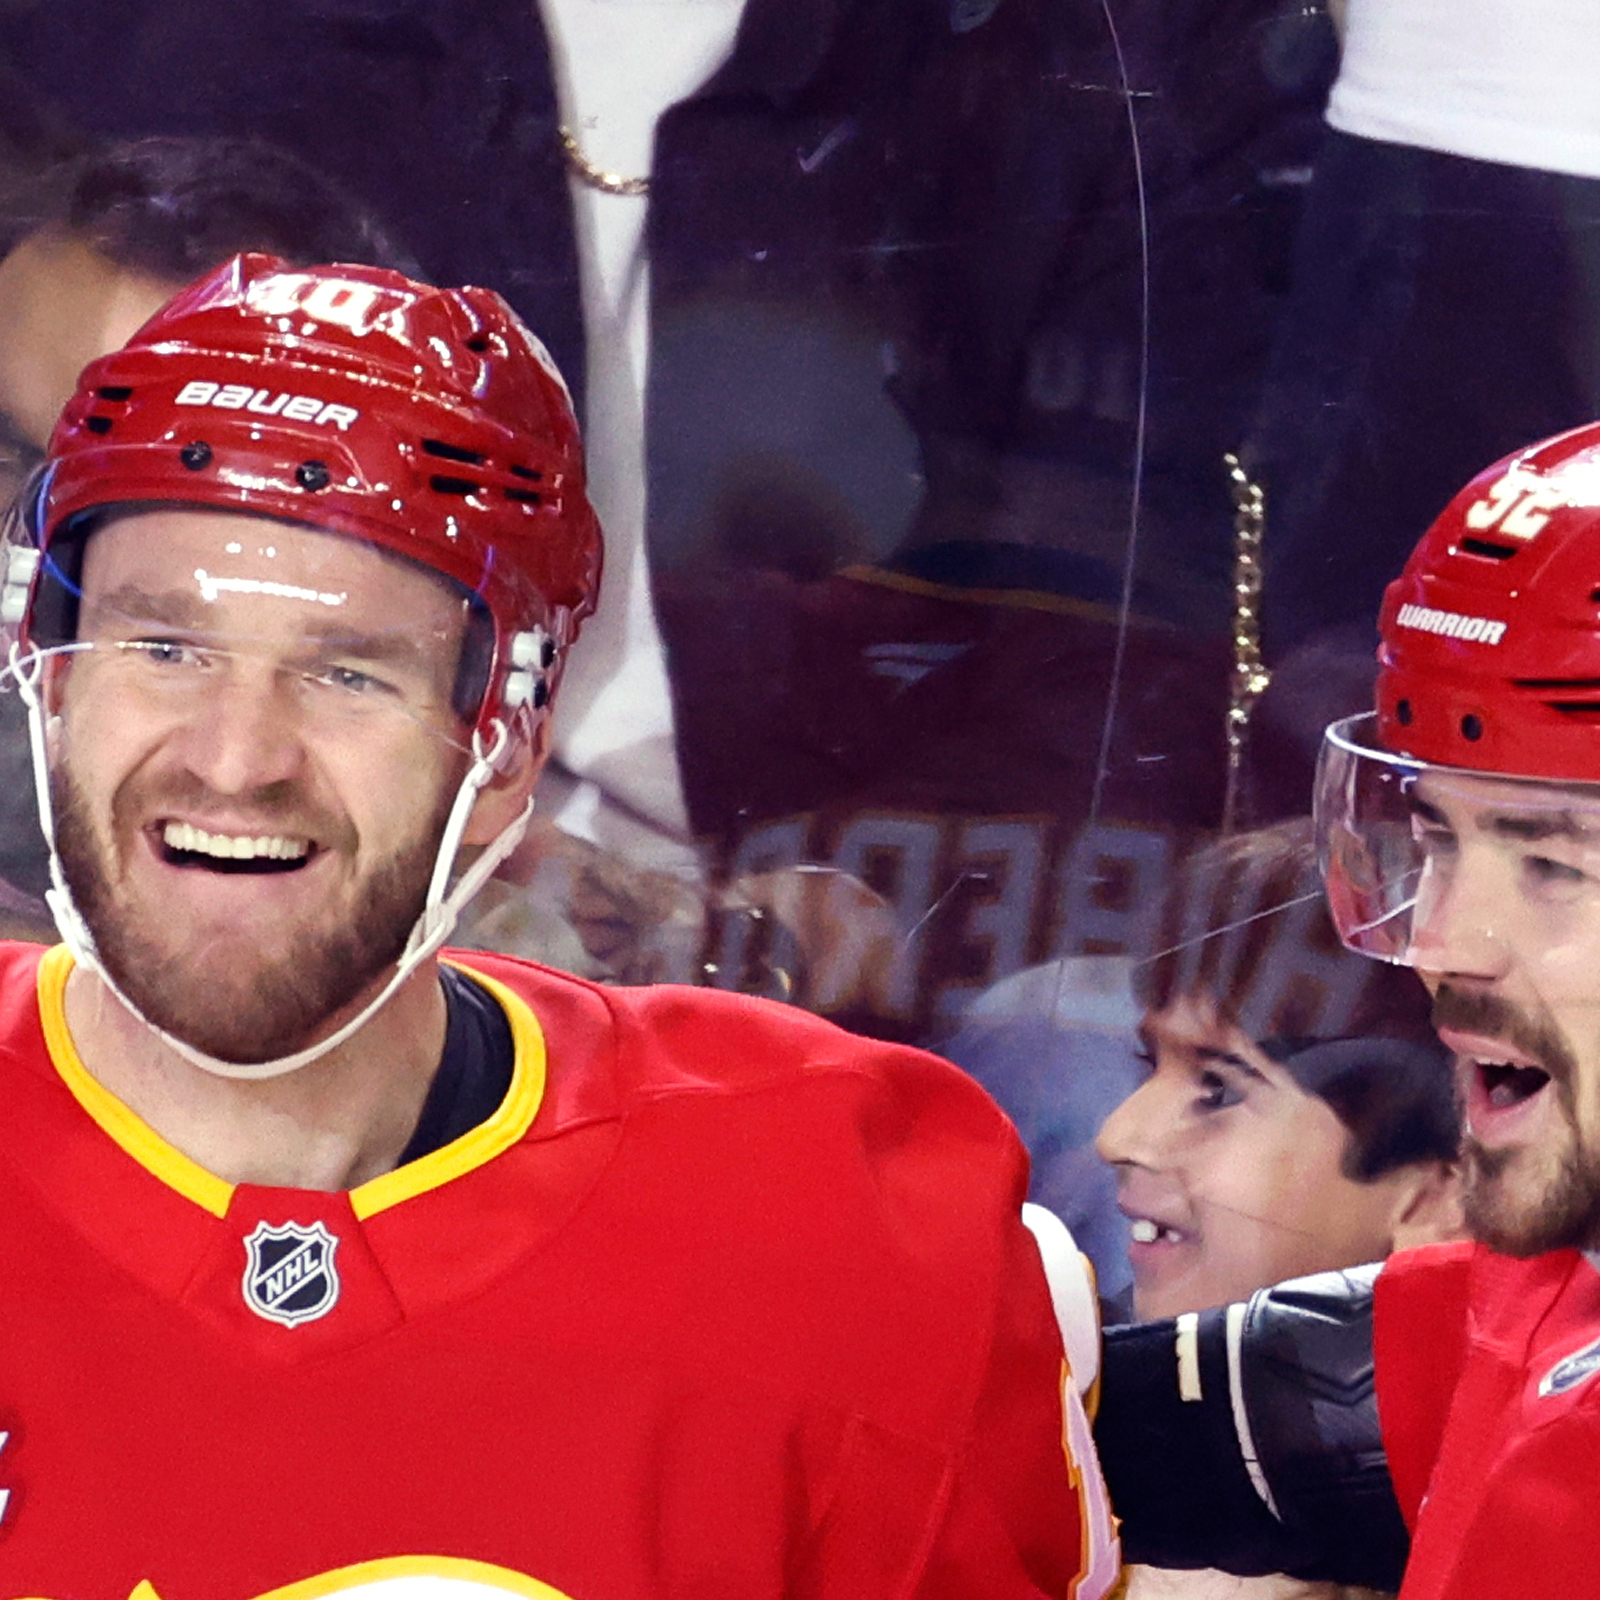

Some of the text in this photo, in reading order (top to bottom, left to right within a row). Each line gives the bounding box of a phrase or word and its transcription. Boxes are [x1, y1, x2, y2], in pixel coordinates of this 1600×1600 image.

[174, 381, 359, 431] BAUER
[1396, 603, 1507, 646] WARRIOR
[265, 1248, 320, 1303] NHL
